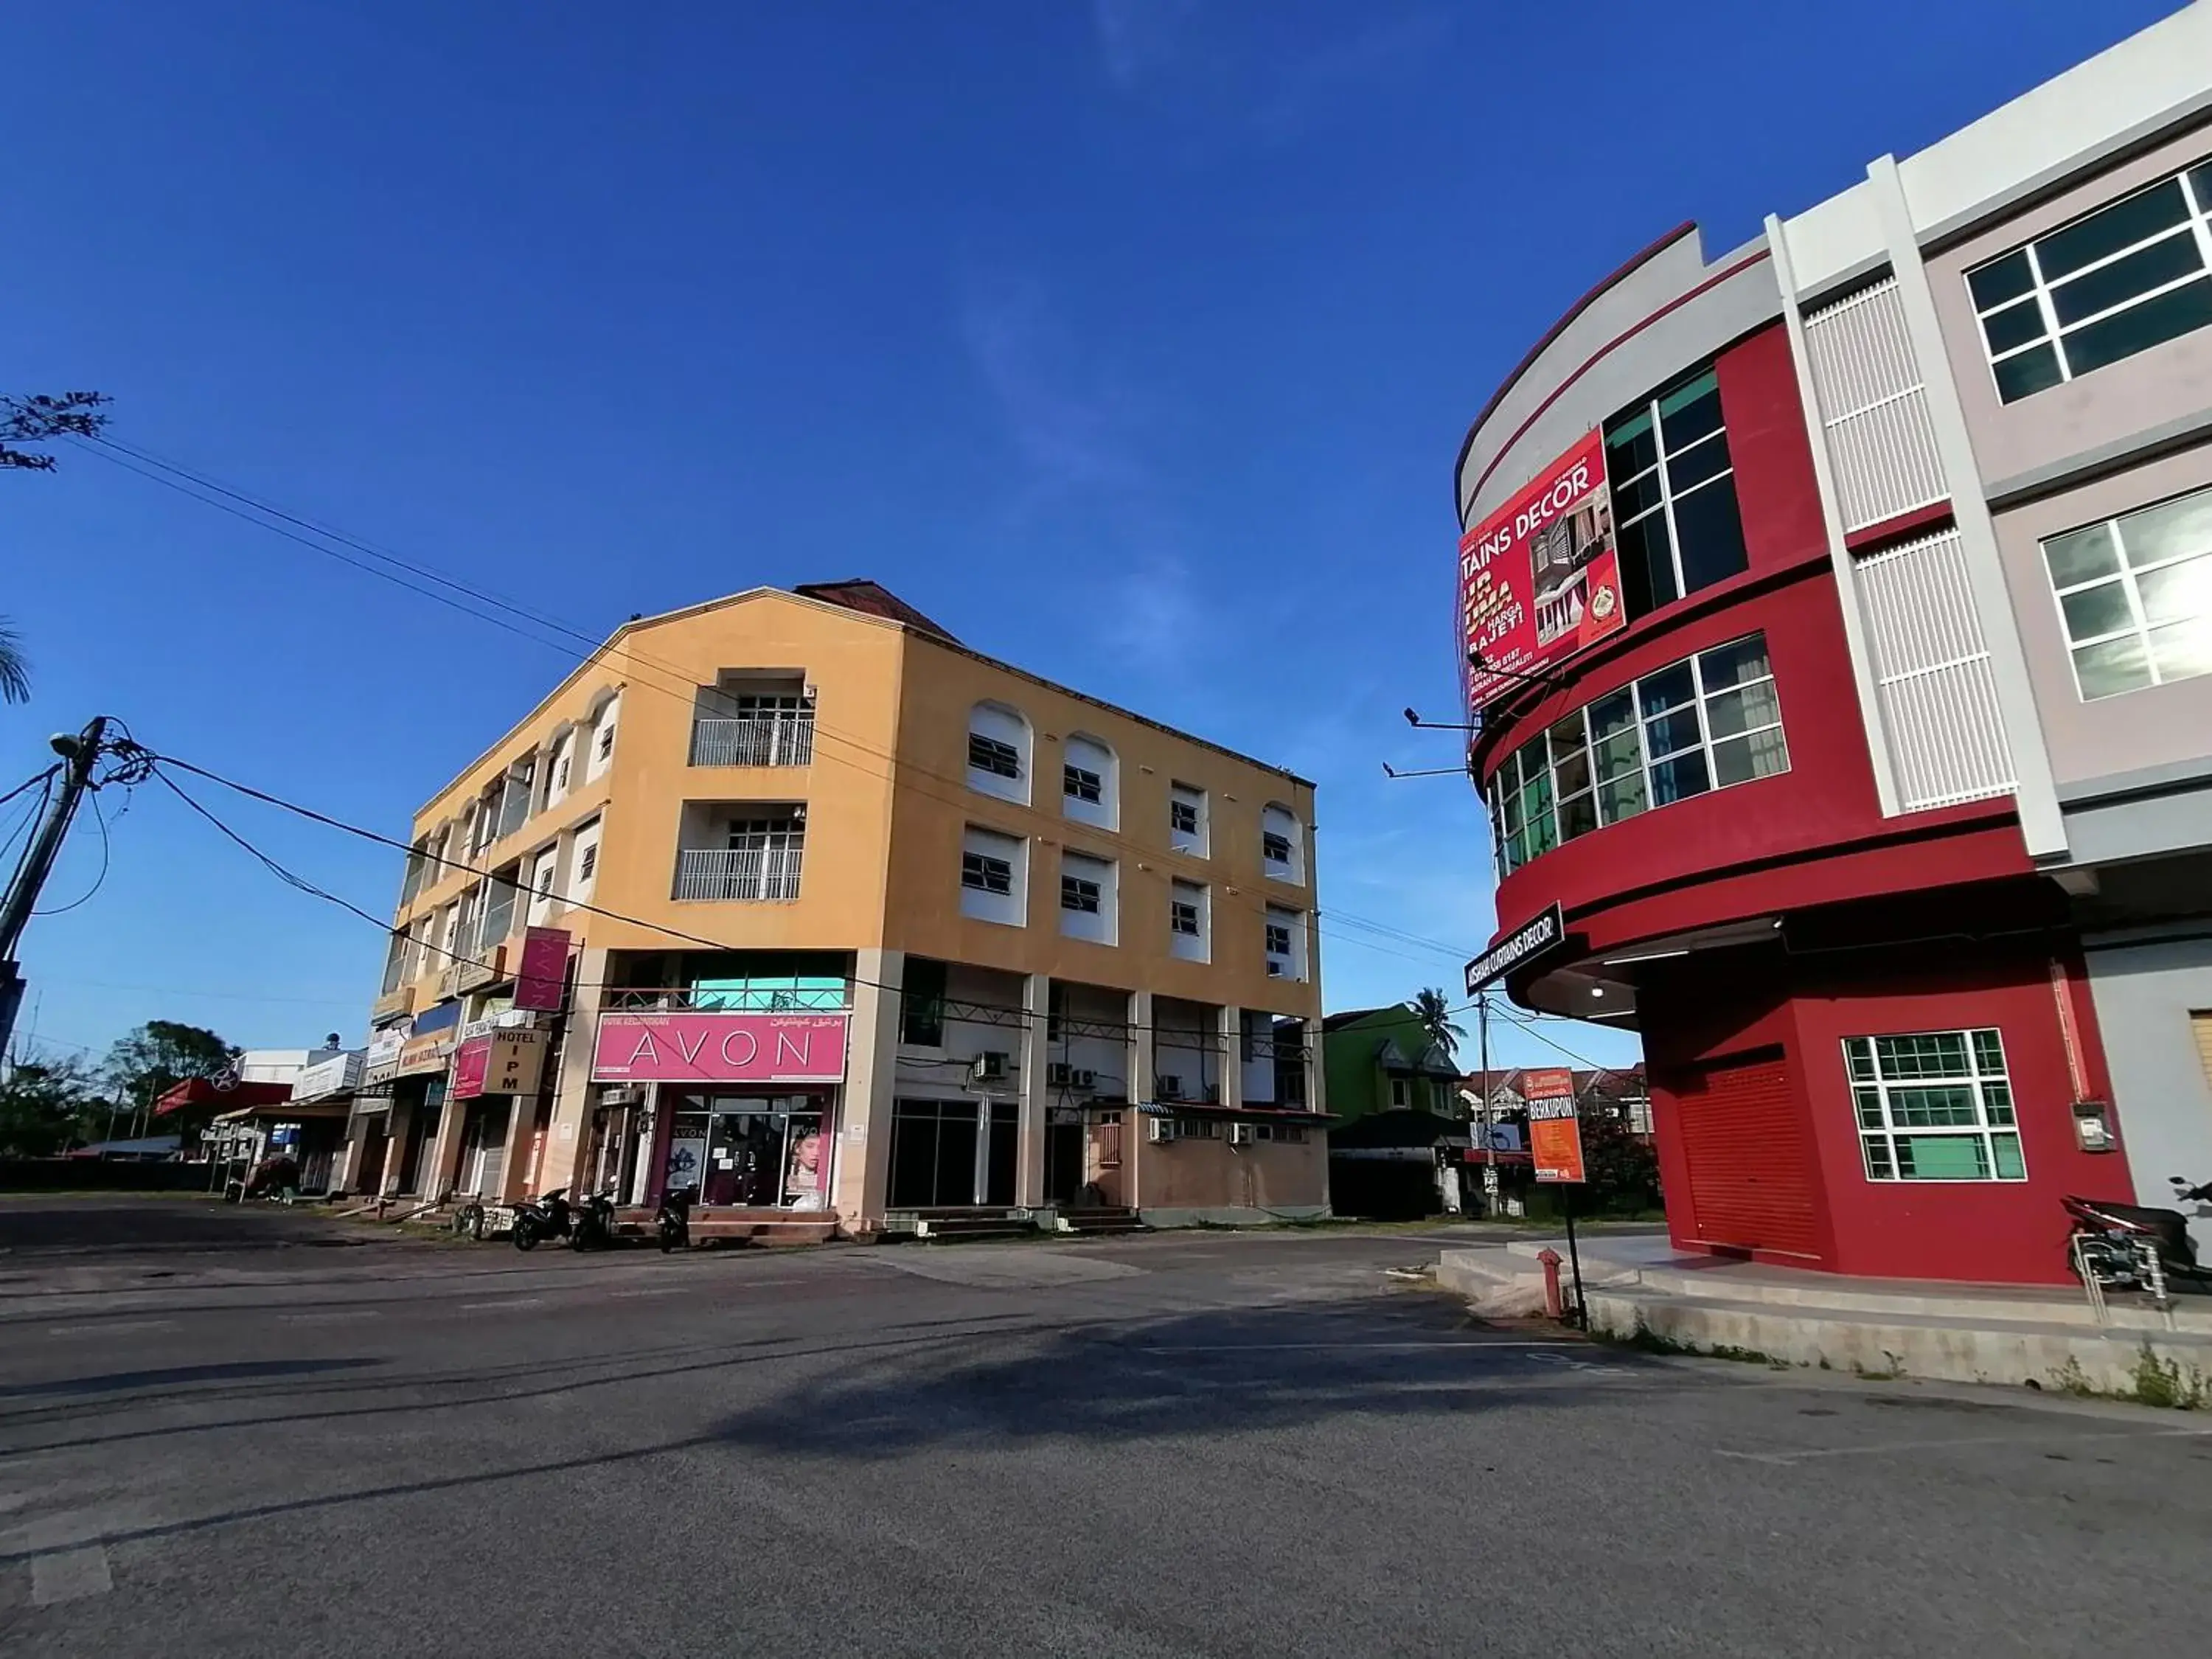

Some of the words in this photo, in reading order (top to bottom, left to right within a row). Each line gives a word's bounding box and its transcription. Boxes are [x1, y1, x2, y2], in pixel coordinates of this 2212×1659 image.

[1515, 466, 1589, 540] DECOR
[1469, 611, 1523, 654] BAJET!
[1488, 602, 1523, 632] HARGA
[1523, 917, 1554, 951] DECOR
[497, 1032, 536, 1043] HOTEL
[627, 1030, 810, 1067] AVON
